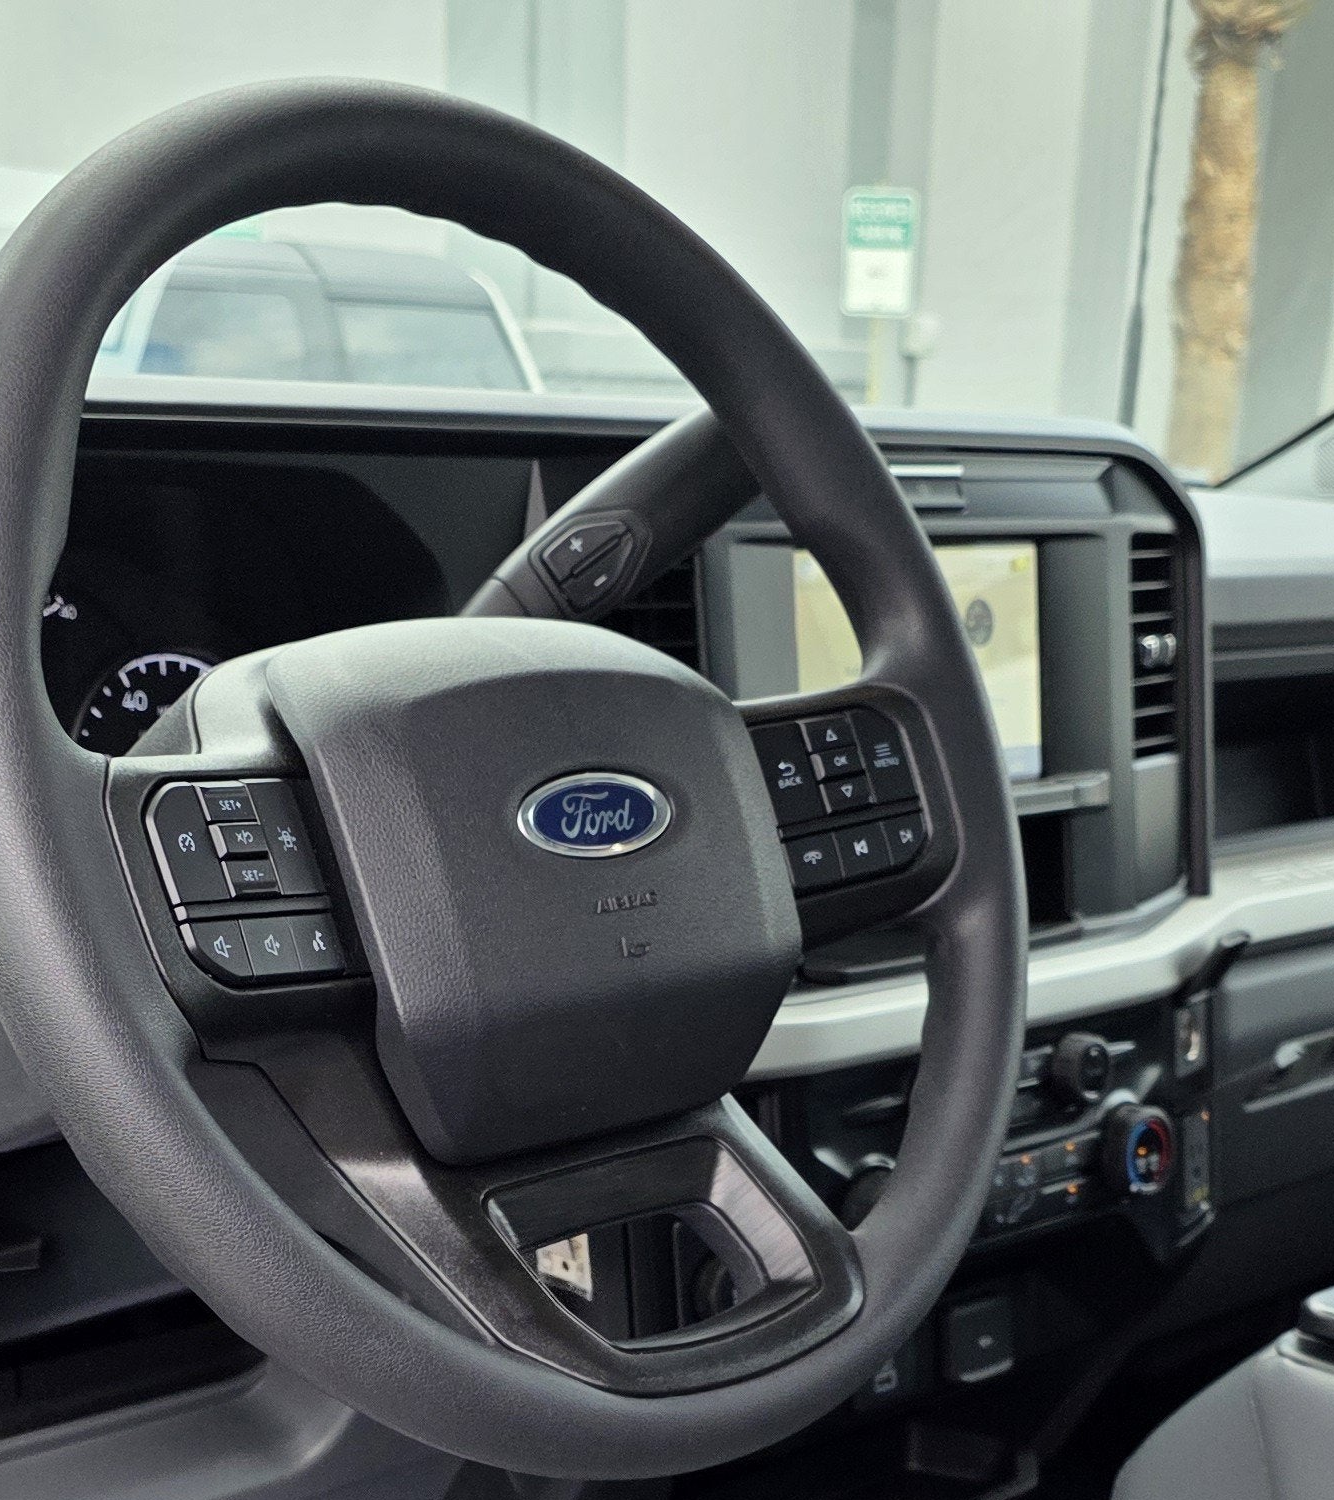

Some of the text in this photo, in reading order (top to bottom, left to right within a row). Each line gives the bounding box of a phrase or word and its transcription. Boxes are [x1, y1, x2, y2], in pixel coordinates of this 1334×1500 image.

[833, 755, 849, 767] OK
[872, 756, 900, 768] MENU
[777, 775, 803, 790] BACK
[560, 790, 635, 840] Ford
